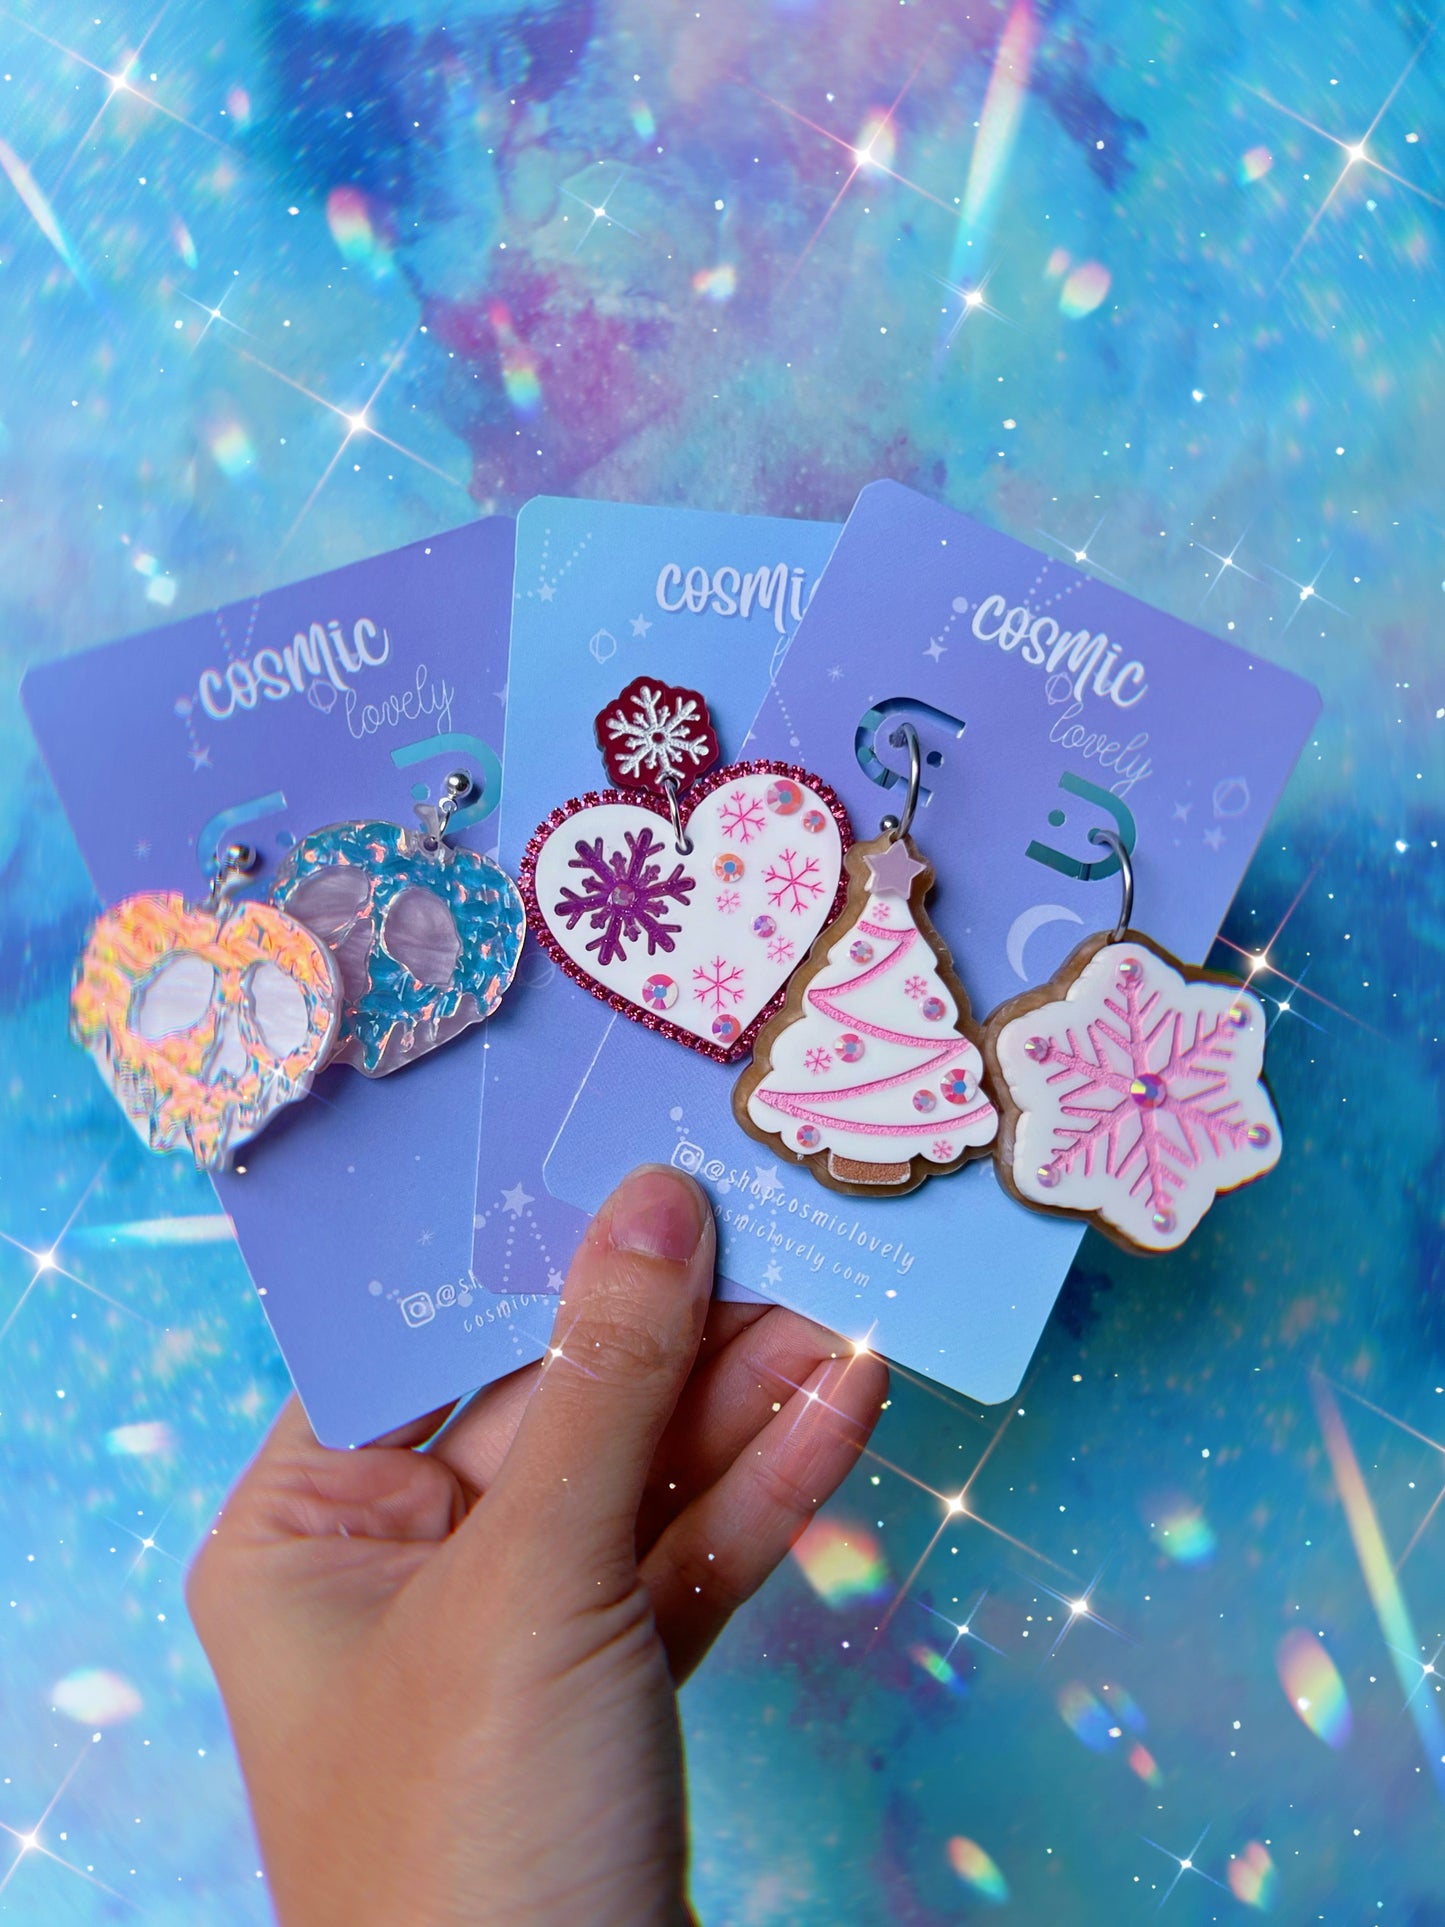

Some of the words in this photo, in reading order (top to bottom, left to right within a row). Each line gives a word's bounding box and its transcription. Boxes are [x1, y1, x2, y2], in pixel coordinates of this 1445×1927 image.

[655, 562, 821, 634] cosmi
[346, 664, 455, 739] lovely
[1049, 701, 1154, 799] lovely
[703, 1159, 916, 1275] @shopcosmiclovely
[714, 1205, 870, 1288] osmiclovely.com
